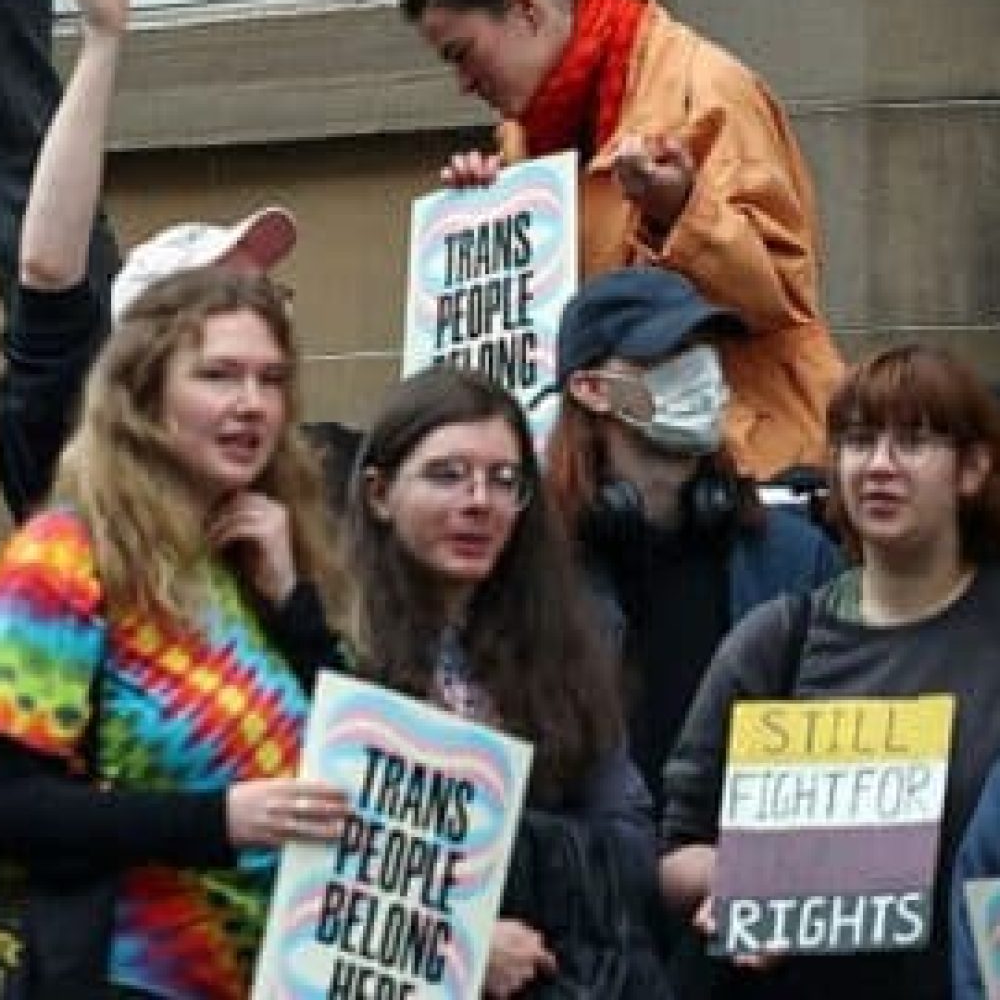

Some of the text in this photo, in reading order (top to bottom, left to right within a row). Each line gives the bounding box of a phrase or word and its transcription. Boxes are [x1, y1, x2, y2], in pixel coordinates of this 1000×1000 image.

[444, 211, 532, 288] TRANS
[436, 271, 534, 349] PEOPLE
[759, 707, 911, 755] STILL
[361, 746, 473, 842] TRANS
[336, 814, 463, 912] PEOPLE
[316, 882, 450, 984] BELONG
[727, 892, 924, 949] RIGHTS
